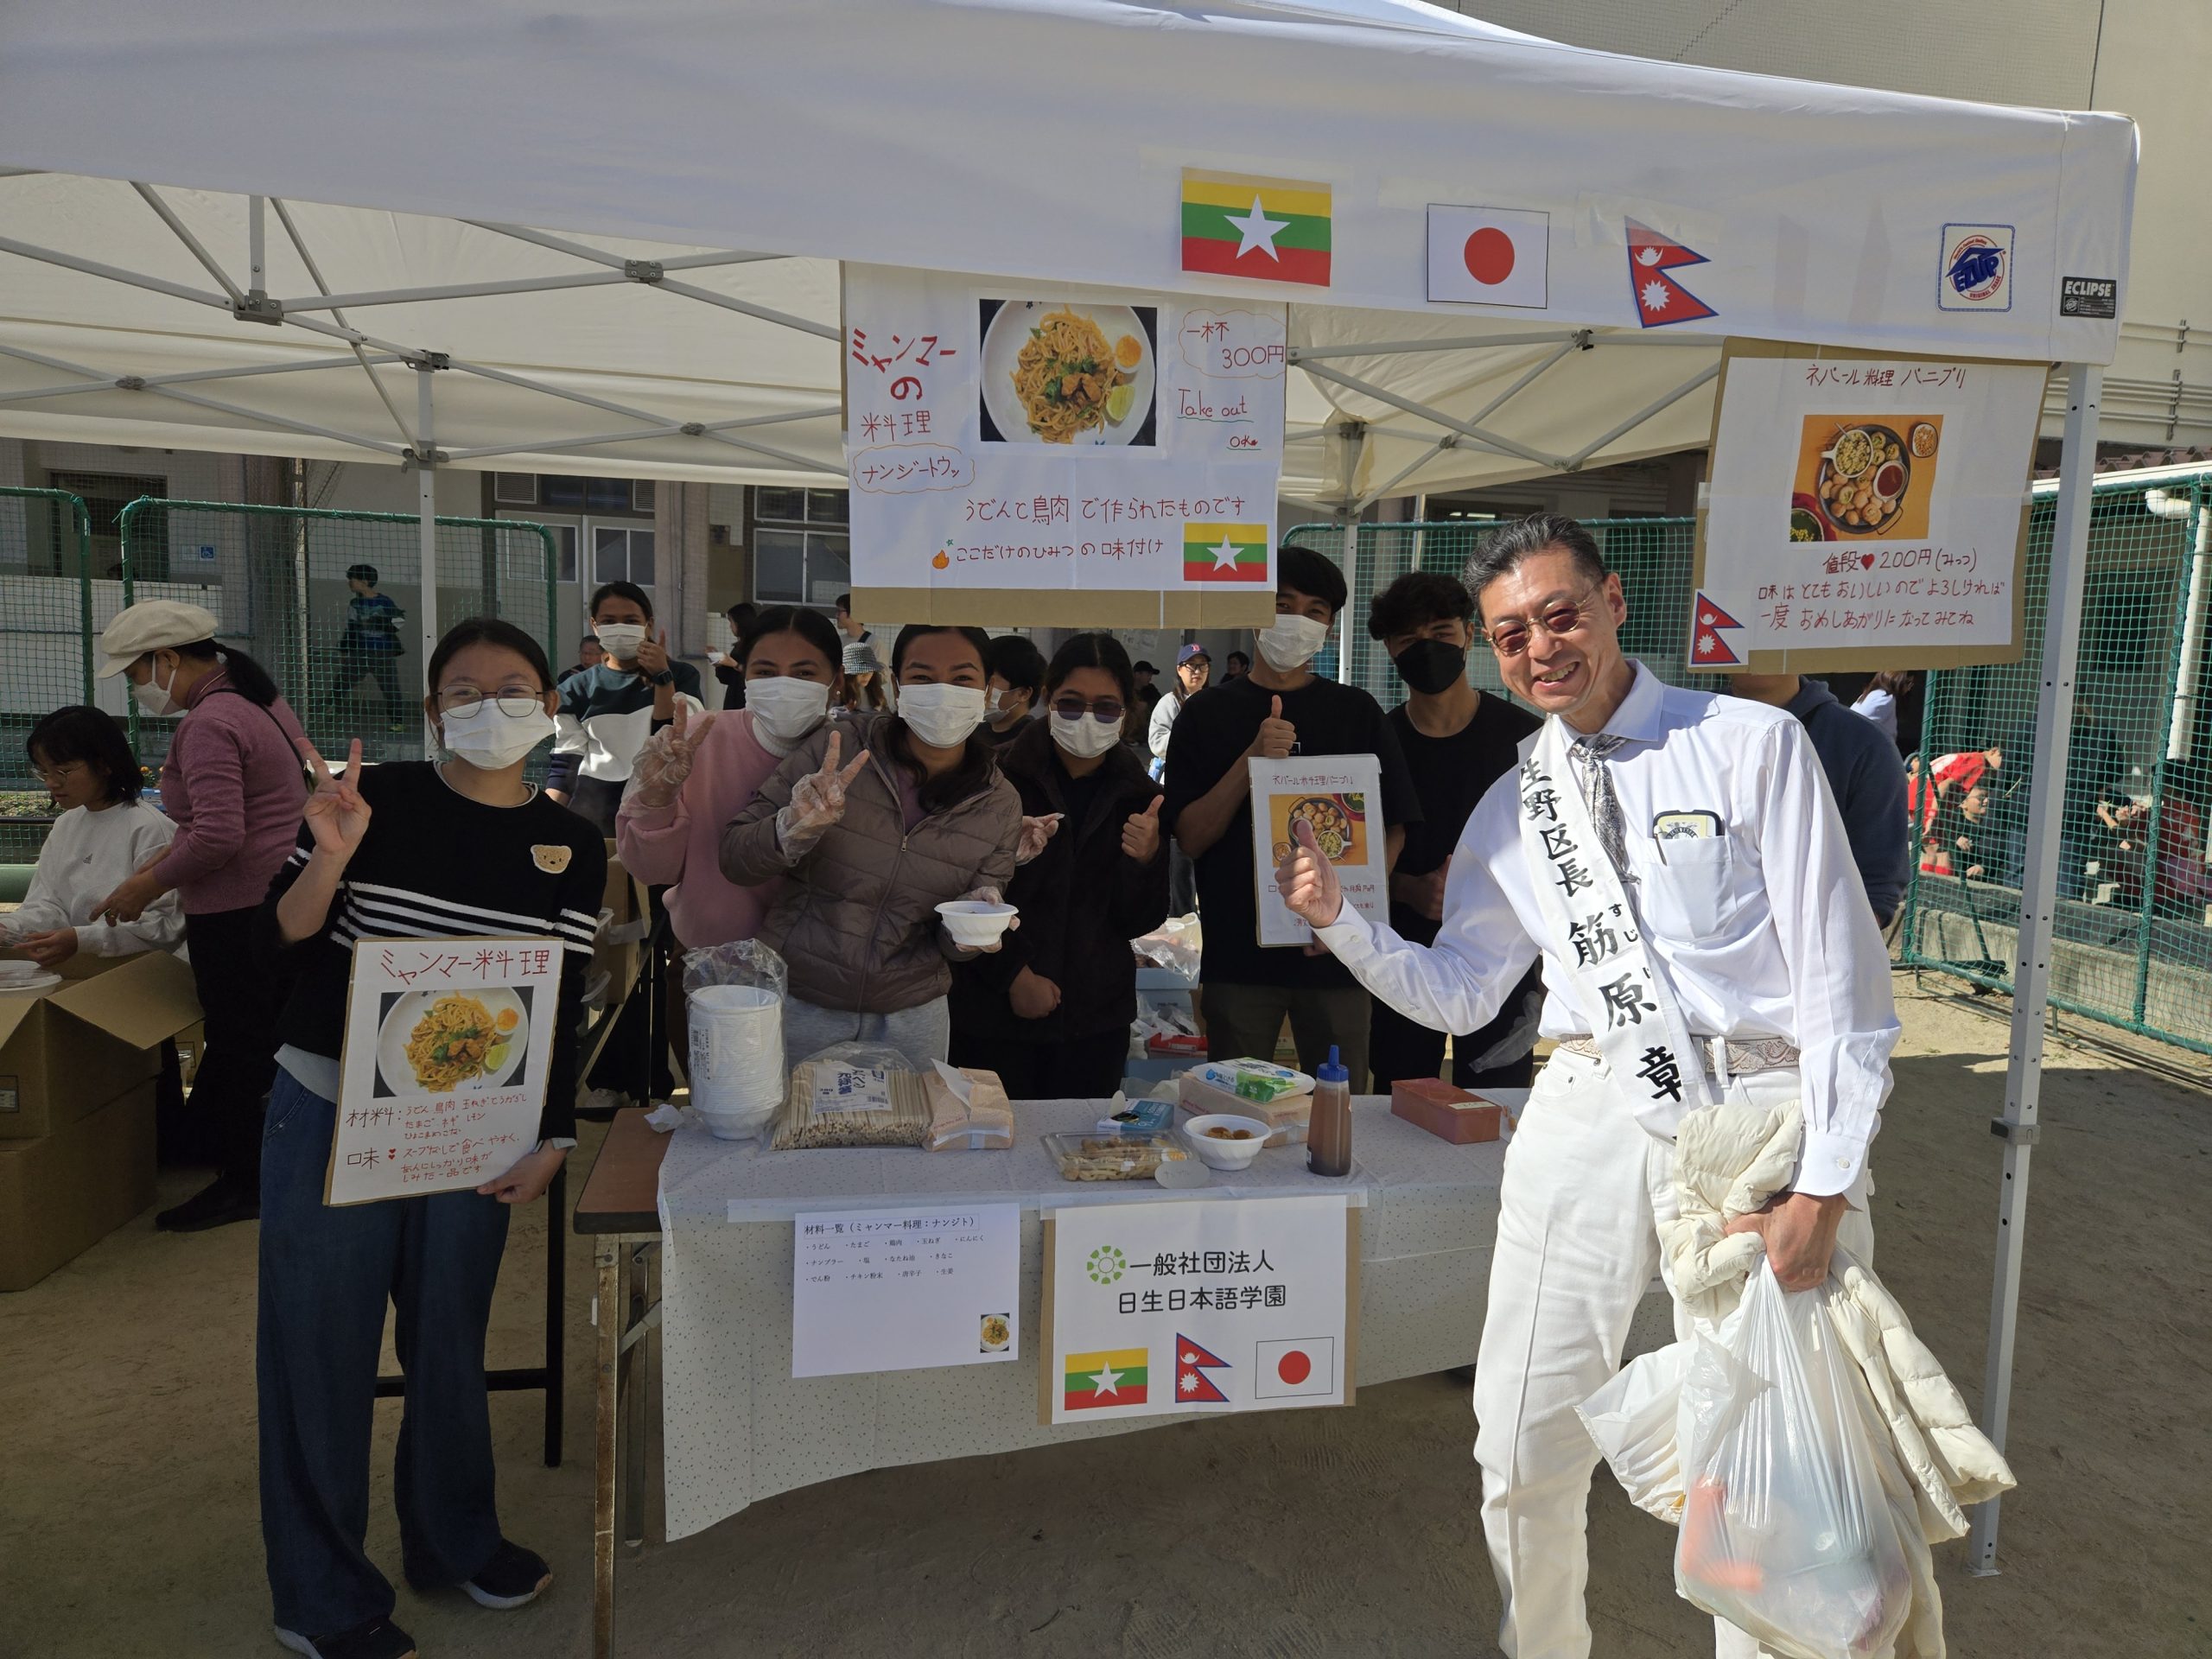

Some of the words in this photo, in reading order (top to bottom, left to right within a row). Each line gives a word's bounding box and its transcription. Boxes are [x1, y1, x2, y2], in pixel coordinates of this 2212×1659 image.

[2064, 280, 2113, 297] ECLIPSE
[1186, 321, 1230, 343] 一杯
[852, 328, 957, 373] ミャンマー
[1222, 346, 1284, 369] 300円
[890, 376, 923, 400] の
[1178, 389, 1213, 417] Take
[1221, 396, 1248, 416] out
[861, 410, 931, 442] 料理
[380, 949, 550, 985] ミャンマー料理
[1129, 1249, 1274, 1277] 一般社団法人
[1118, 1284, 1286, 1314] 日生日本語学園
